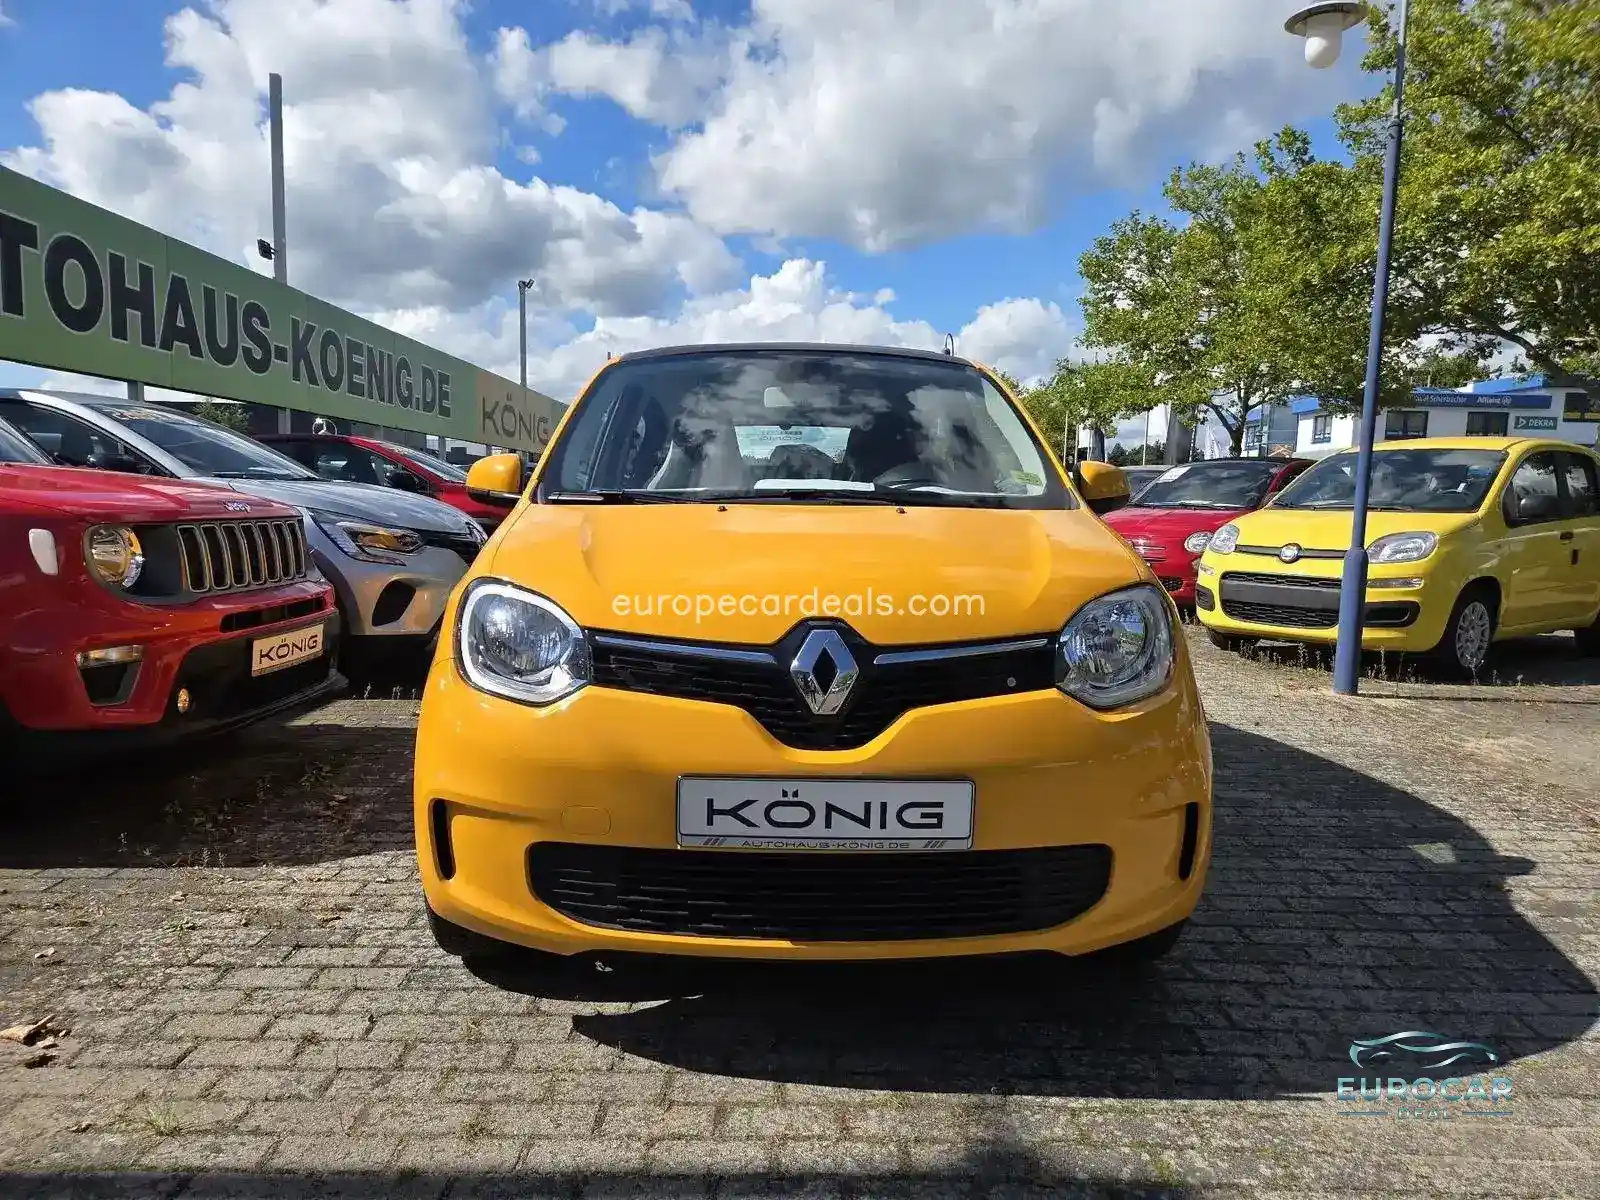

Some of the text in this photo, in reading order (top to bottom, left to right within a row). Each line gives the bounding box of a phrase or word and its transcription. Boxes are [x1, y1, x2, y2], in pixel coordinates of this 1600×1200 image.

[0, 208, 452, 420] TOHAUS-KOENIG.DE
[481, 392, 549, 446] KÖNIG
[1528, 419, 1554, 427] DEKRA
[259, 634, 318, 664] KÖNIG
[706, 787, 944, 829] KÖNIG
[740, 839, 911, 849] AUTOHAUS-KÖNIG.DE
